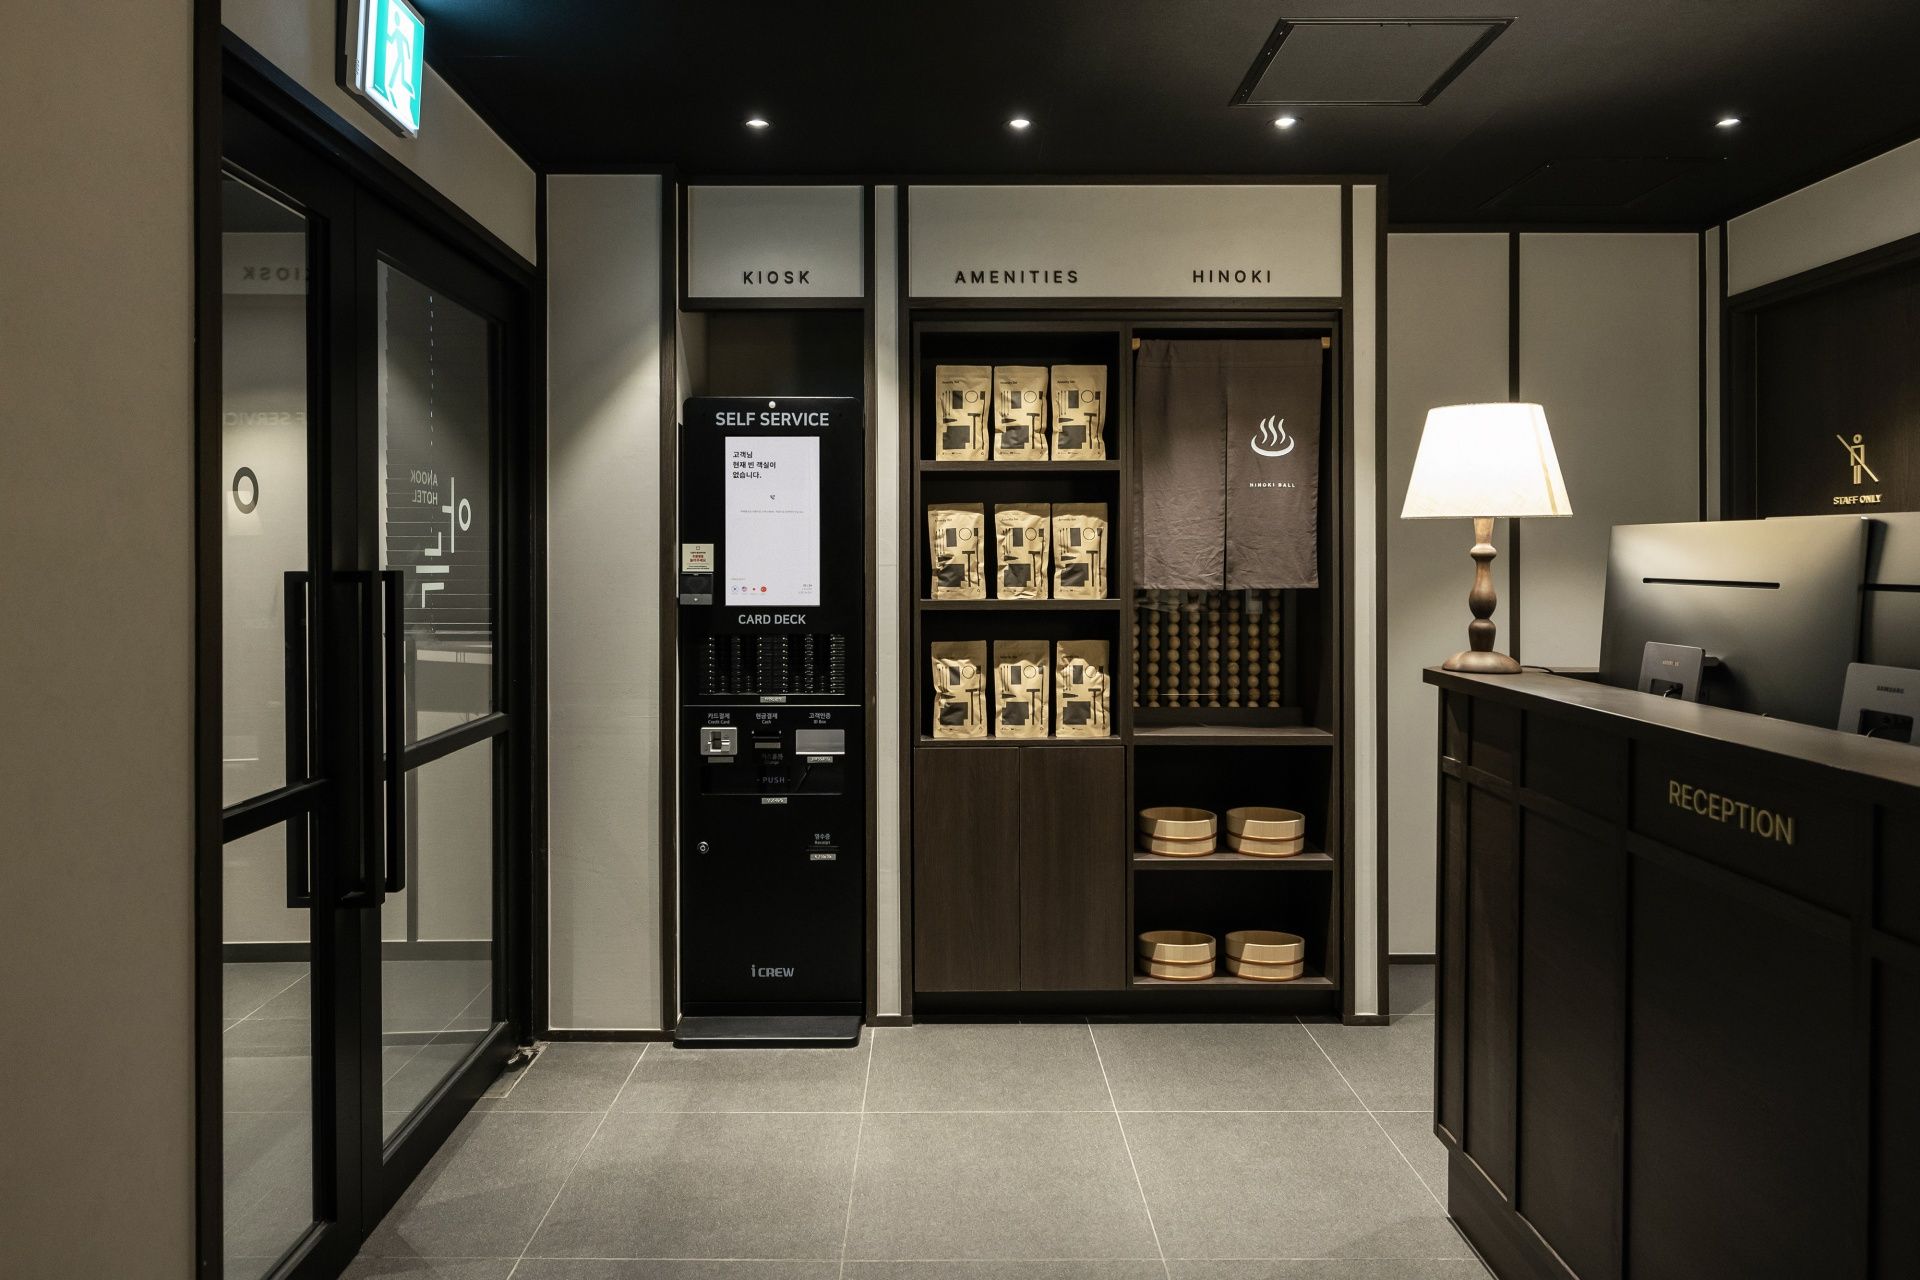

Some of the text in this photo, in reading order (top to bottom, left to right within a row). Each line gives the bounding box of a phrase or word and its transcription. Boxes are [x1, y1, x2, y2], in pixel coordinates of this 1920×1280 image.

[743, 270, 810, 285] KIOSK
[954, 270, 1079, 284] AMENITIES
[1192, 270, 1271, 284] HINOKI
[715, 412, 830, 426] SELF SERVICE
[1833, 494, 1882, 504] STAFF ONLY
[738, 614, 806, 625] CARD DECK
[1668, 780, 1795, 845] RECEPTION
